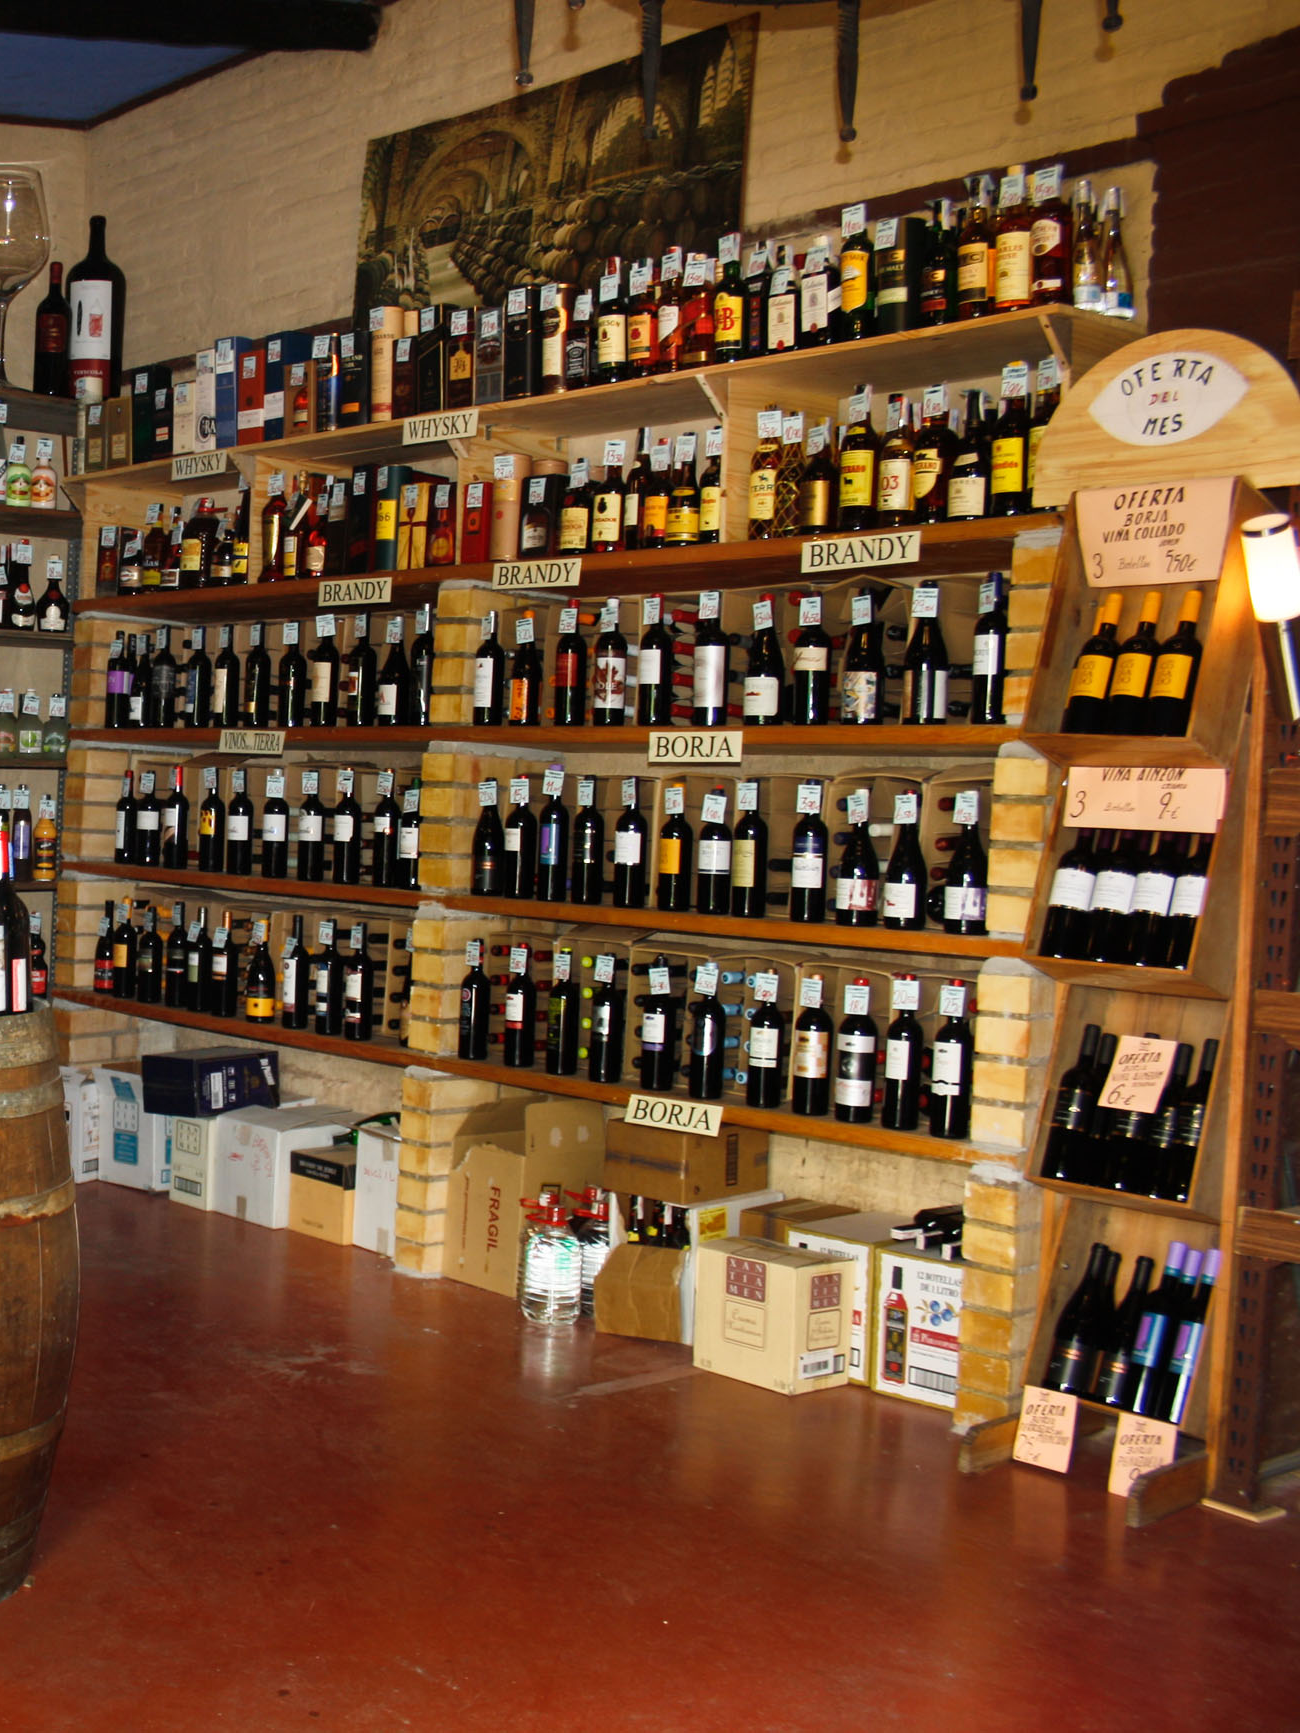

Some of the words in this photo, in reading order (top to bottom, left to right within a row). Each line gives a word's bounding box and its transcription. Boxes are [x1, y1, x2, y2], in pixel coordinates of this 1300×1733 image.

[1121, 358, 1215, 397] OFERTA
[1149, 391, 1180, 406] DEL
[408, 413, 474, 441] WHYSKY
[1142, 414, 1184, 436] MES
[175, 453, 224, 476] WHYSKY
[1114, 486, 1186, 510] OFERTA
[1124, 509, 1169, 528] BORJA
[1134, 523, 1185, 541] COLLADO
[810, 535, 914, 567] BRANDY
[497, 562, 576, 586] BRANDY
[1093, 552, 1104, 580] 3
[323, 580, 389, 602] BRANDY
[224, 733, 247, 749] VINOS
[253, 733, 281, 751] TIERRA
[655, 734, 734, 759] BORJA
[1070, 790, 1087, 819] 3
[1118, 1051, 1162, 1066] OFERTA
[631, 1098, 712, 1133] BORJA
[485, 1186, 501, 1254] FRAGIL
[1025, 1404, 1067, 1417] OFERTA
[1119, 1434, 1163, 1446] OFERTA
